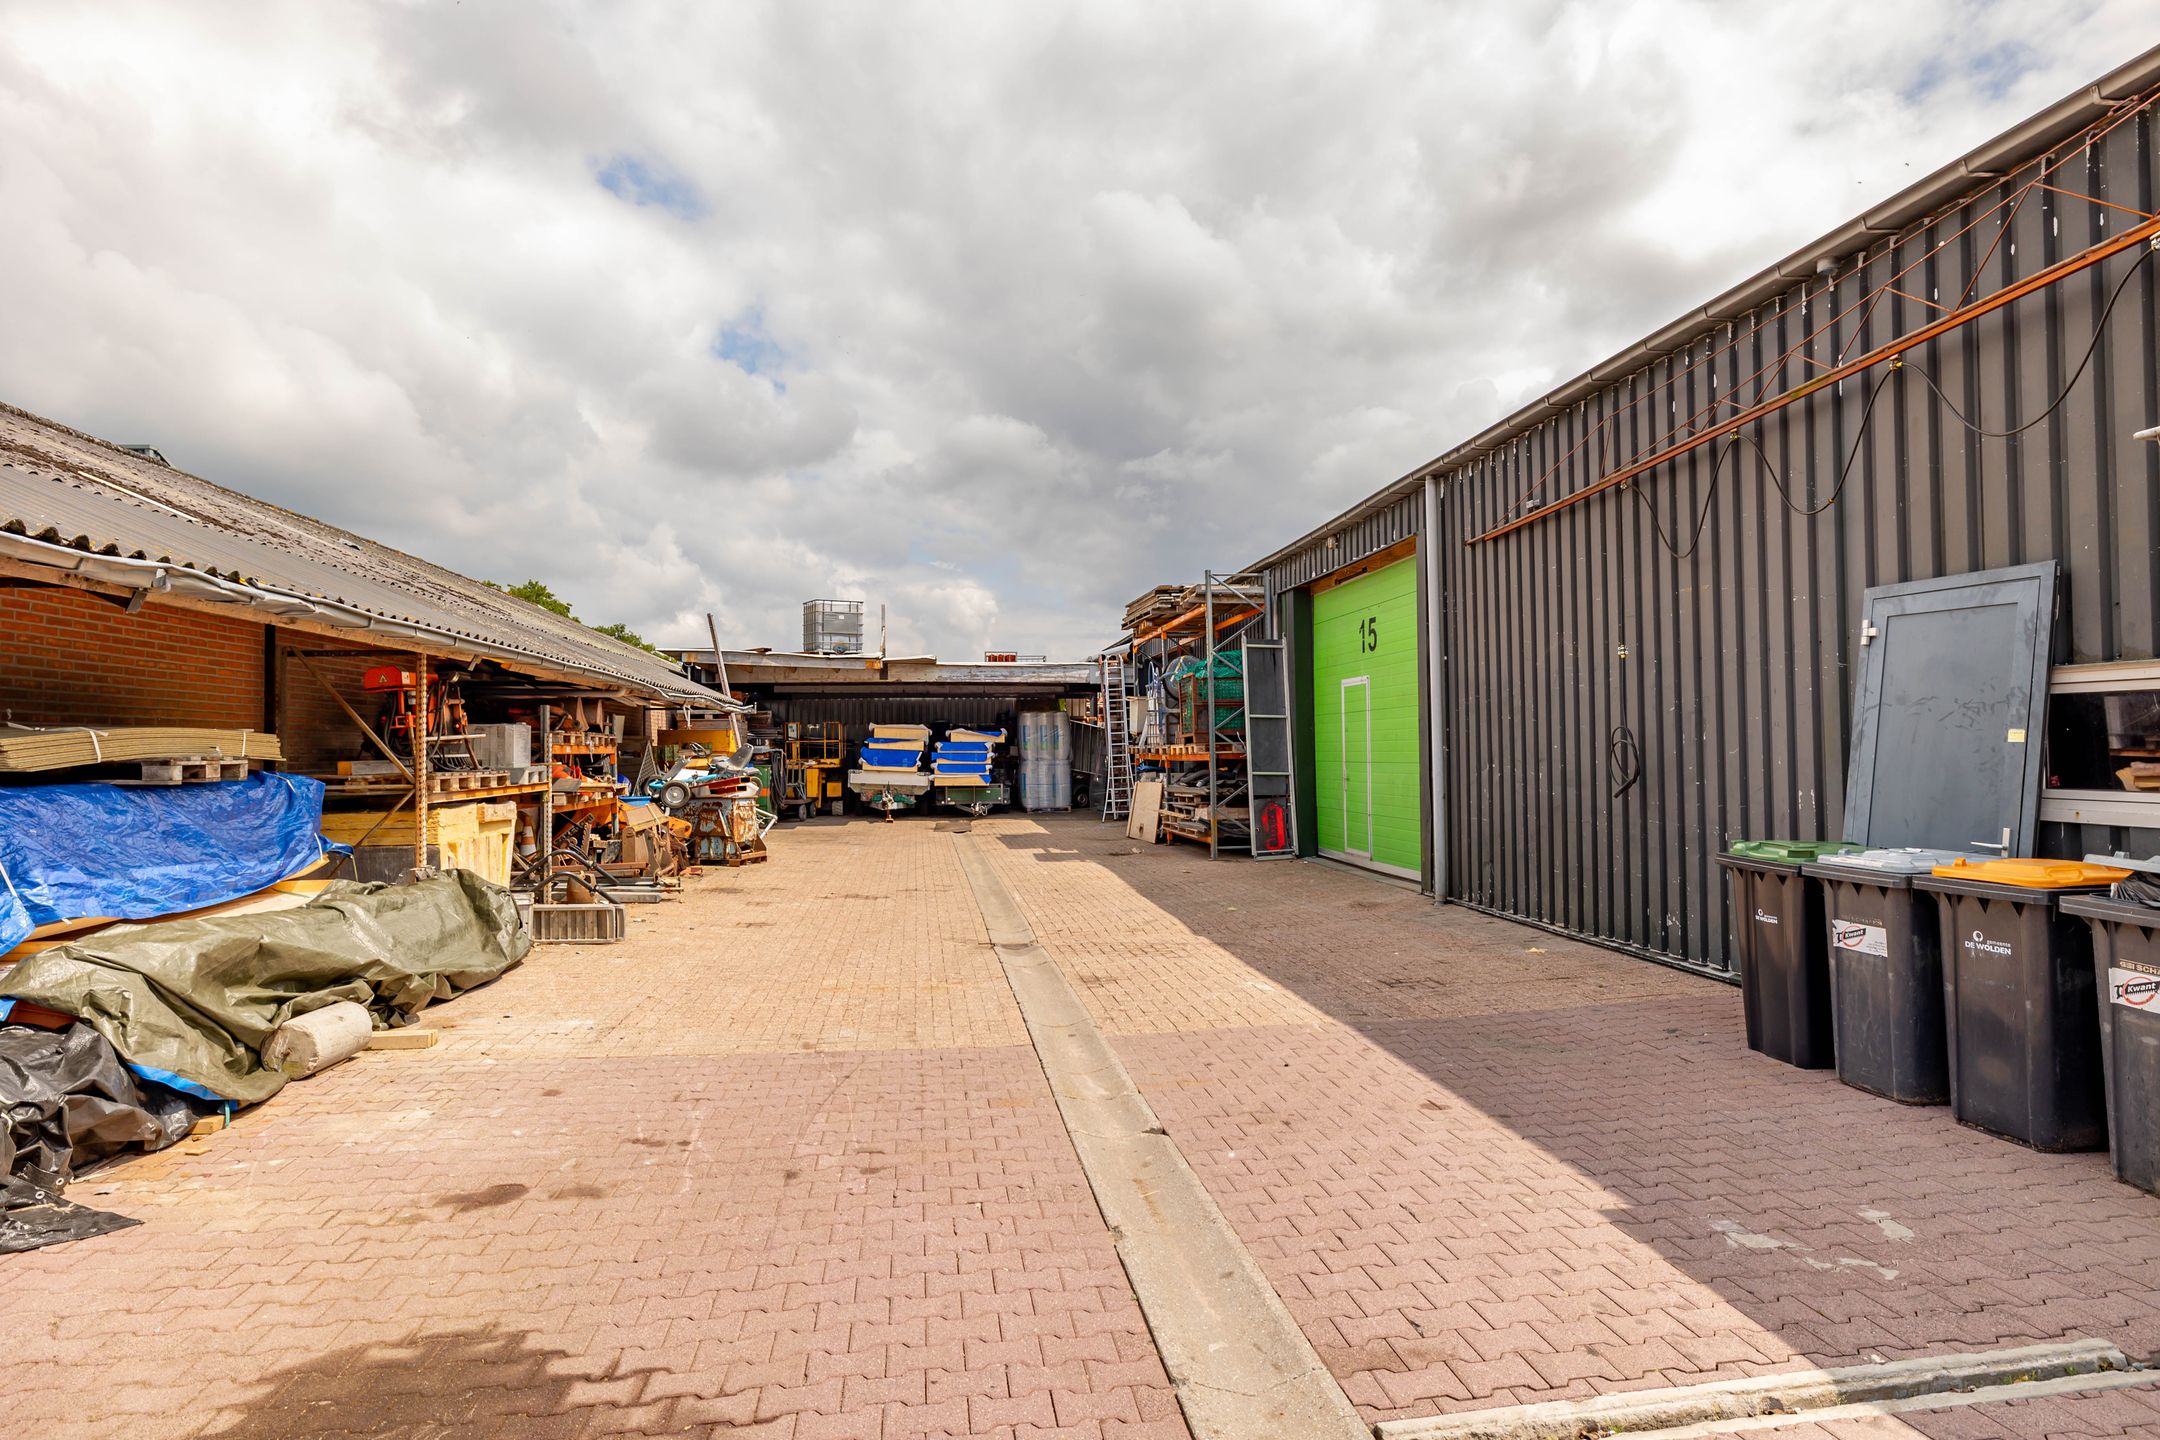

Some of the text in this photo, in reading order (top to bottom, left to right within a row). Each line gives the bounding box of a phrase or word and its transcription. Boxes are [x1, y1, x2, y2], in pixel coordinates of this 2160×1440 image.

[1359, 616, 1377, 653] 15
[1965, 940, 2011, 955] DE WOLDEN
[2127, 983, 2156, 993] Kwant
